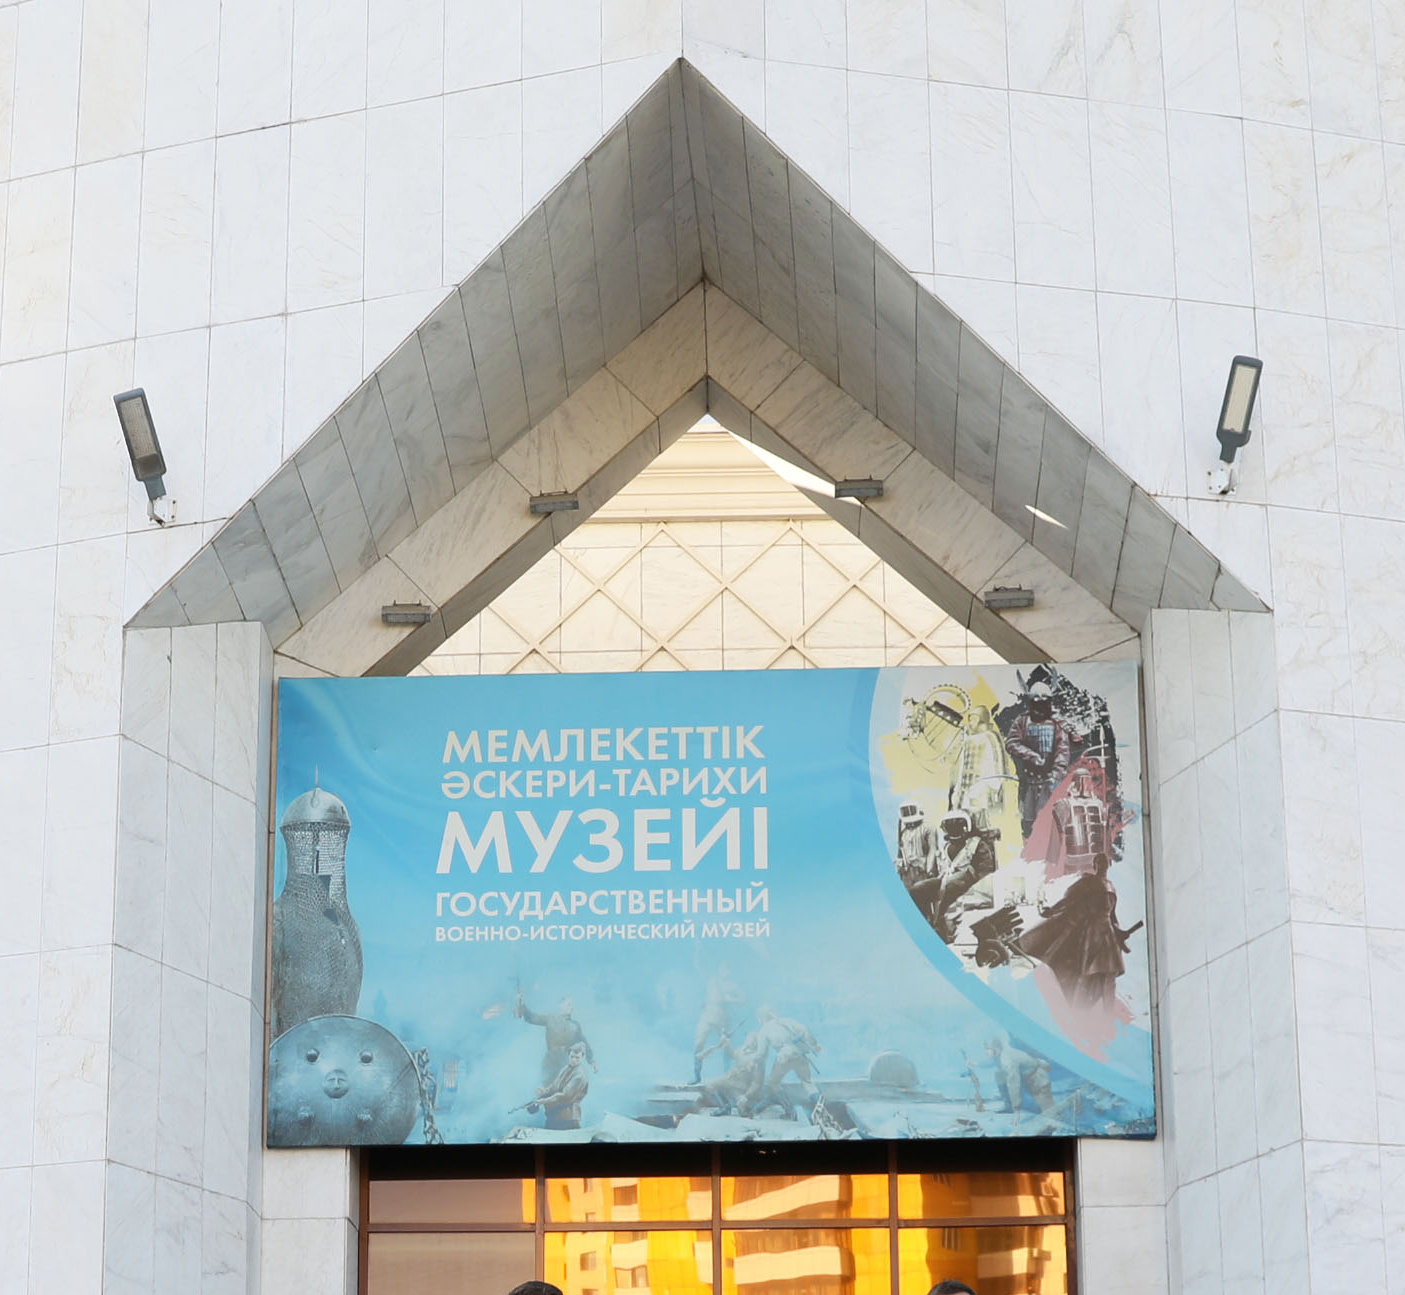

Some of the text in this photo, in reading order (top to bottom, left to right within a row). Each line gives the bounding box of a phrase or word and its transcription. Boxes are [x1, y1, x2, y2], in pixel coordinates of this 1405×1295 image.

[442, 725, 765, 763] МЕМЛЕКЕТТІК
[441, 766, 768, 799] ӘСКЕРИ-ТАРИХИ
[435, 796, 769, 874] МУЗЕЙІ
[435, 881, 770, 921] ГОСУДАРСТВЕННЫЙ
[435, 918, 771, 943] ВОЕННО-ИСТОРИЧЕСКИЙ МУЗЕЙ
